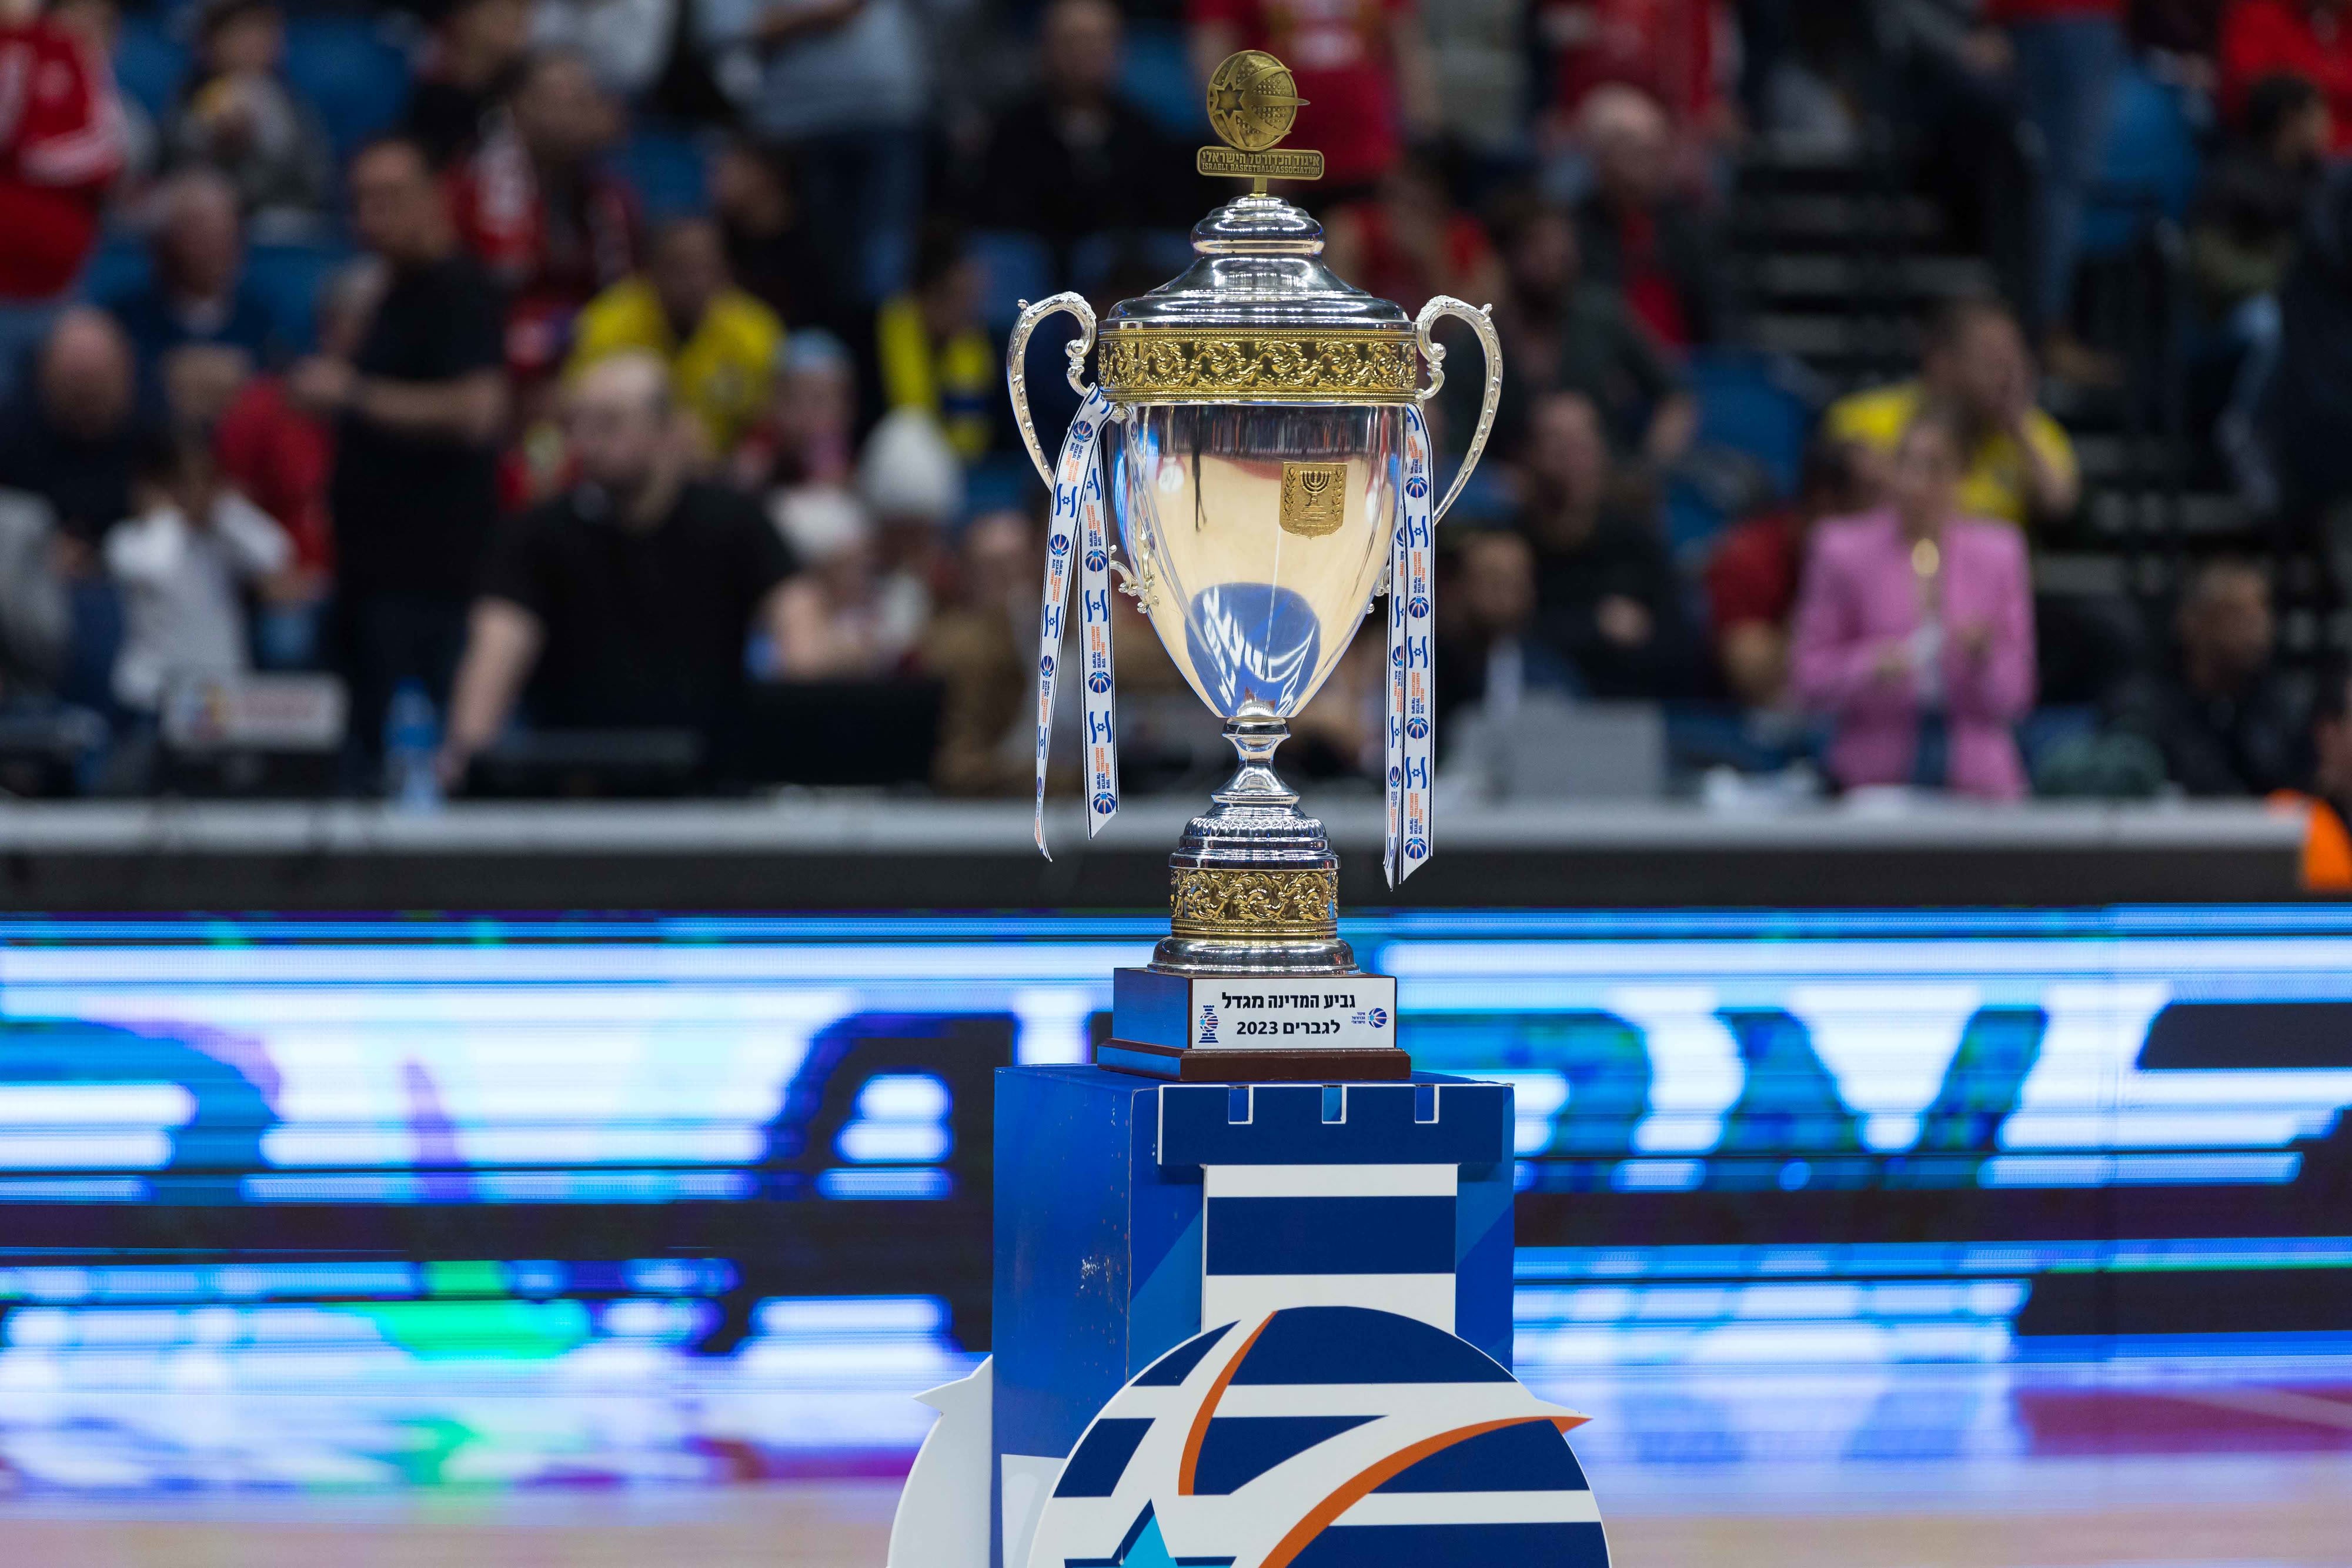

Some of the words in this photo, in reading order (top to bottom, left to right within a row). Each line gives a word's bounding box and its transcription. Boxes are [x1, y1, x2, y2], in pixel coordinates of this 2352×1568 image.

[1202, 151, 1246, 164] הישראלי
[1248, 153, 1292, 165] הכדורסל
[1295, 155, 1319, 166] איגוד
[1202, 162, 1228, 170] ISRAELI
[1230, 164, 1274, 173] BASKETBALL
[1275, 166, 1319, 174] ASSOCIATION
[1221, 992, 1264, 1009] מגדל
[1268, 994, 1319, 1008] המדינה
[1324, 994, 1355, 1009] גביע
[1237, 1021, 1278, 1035] 2023
[1283, 1019, 1340, 1035] לגברים
